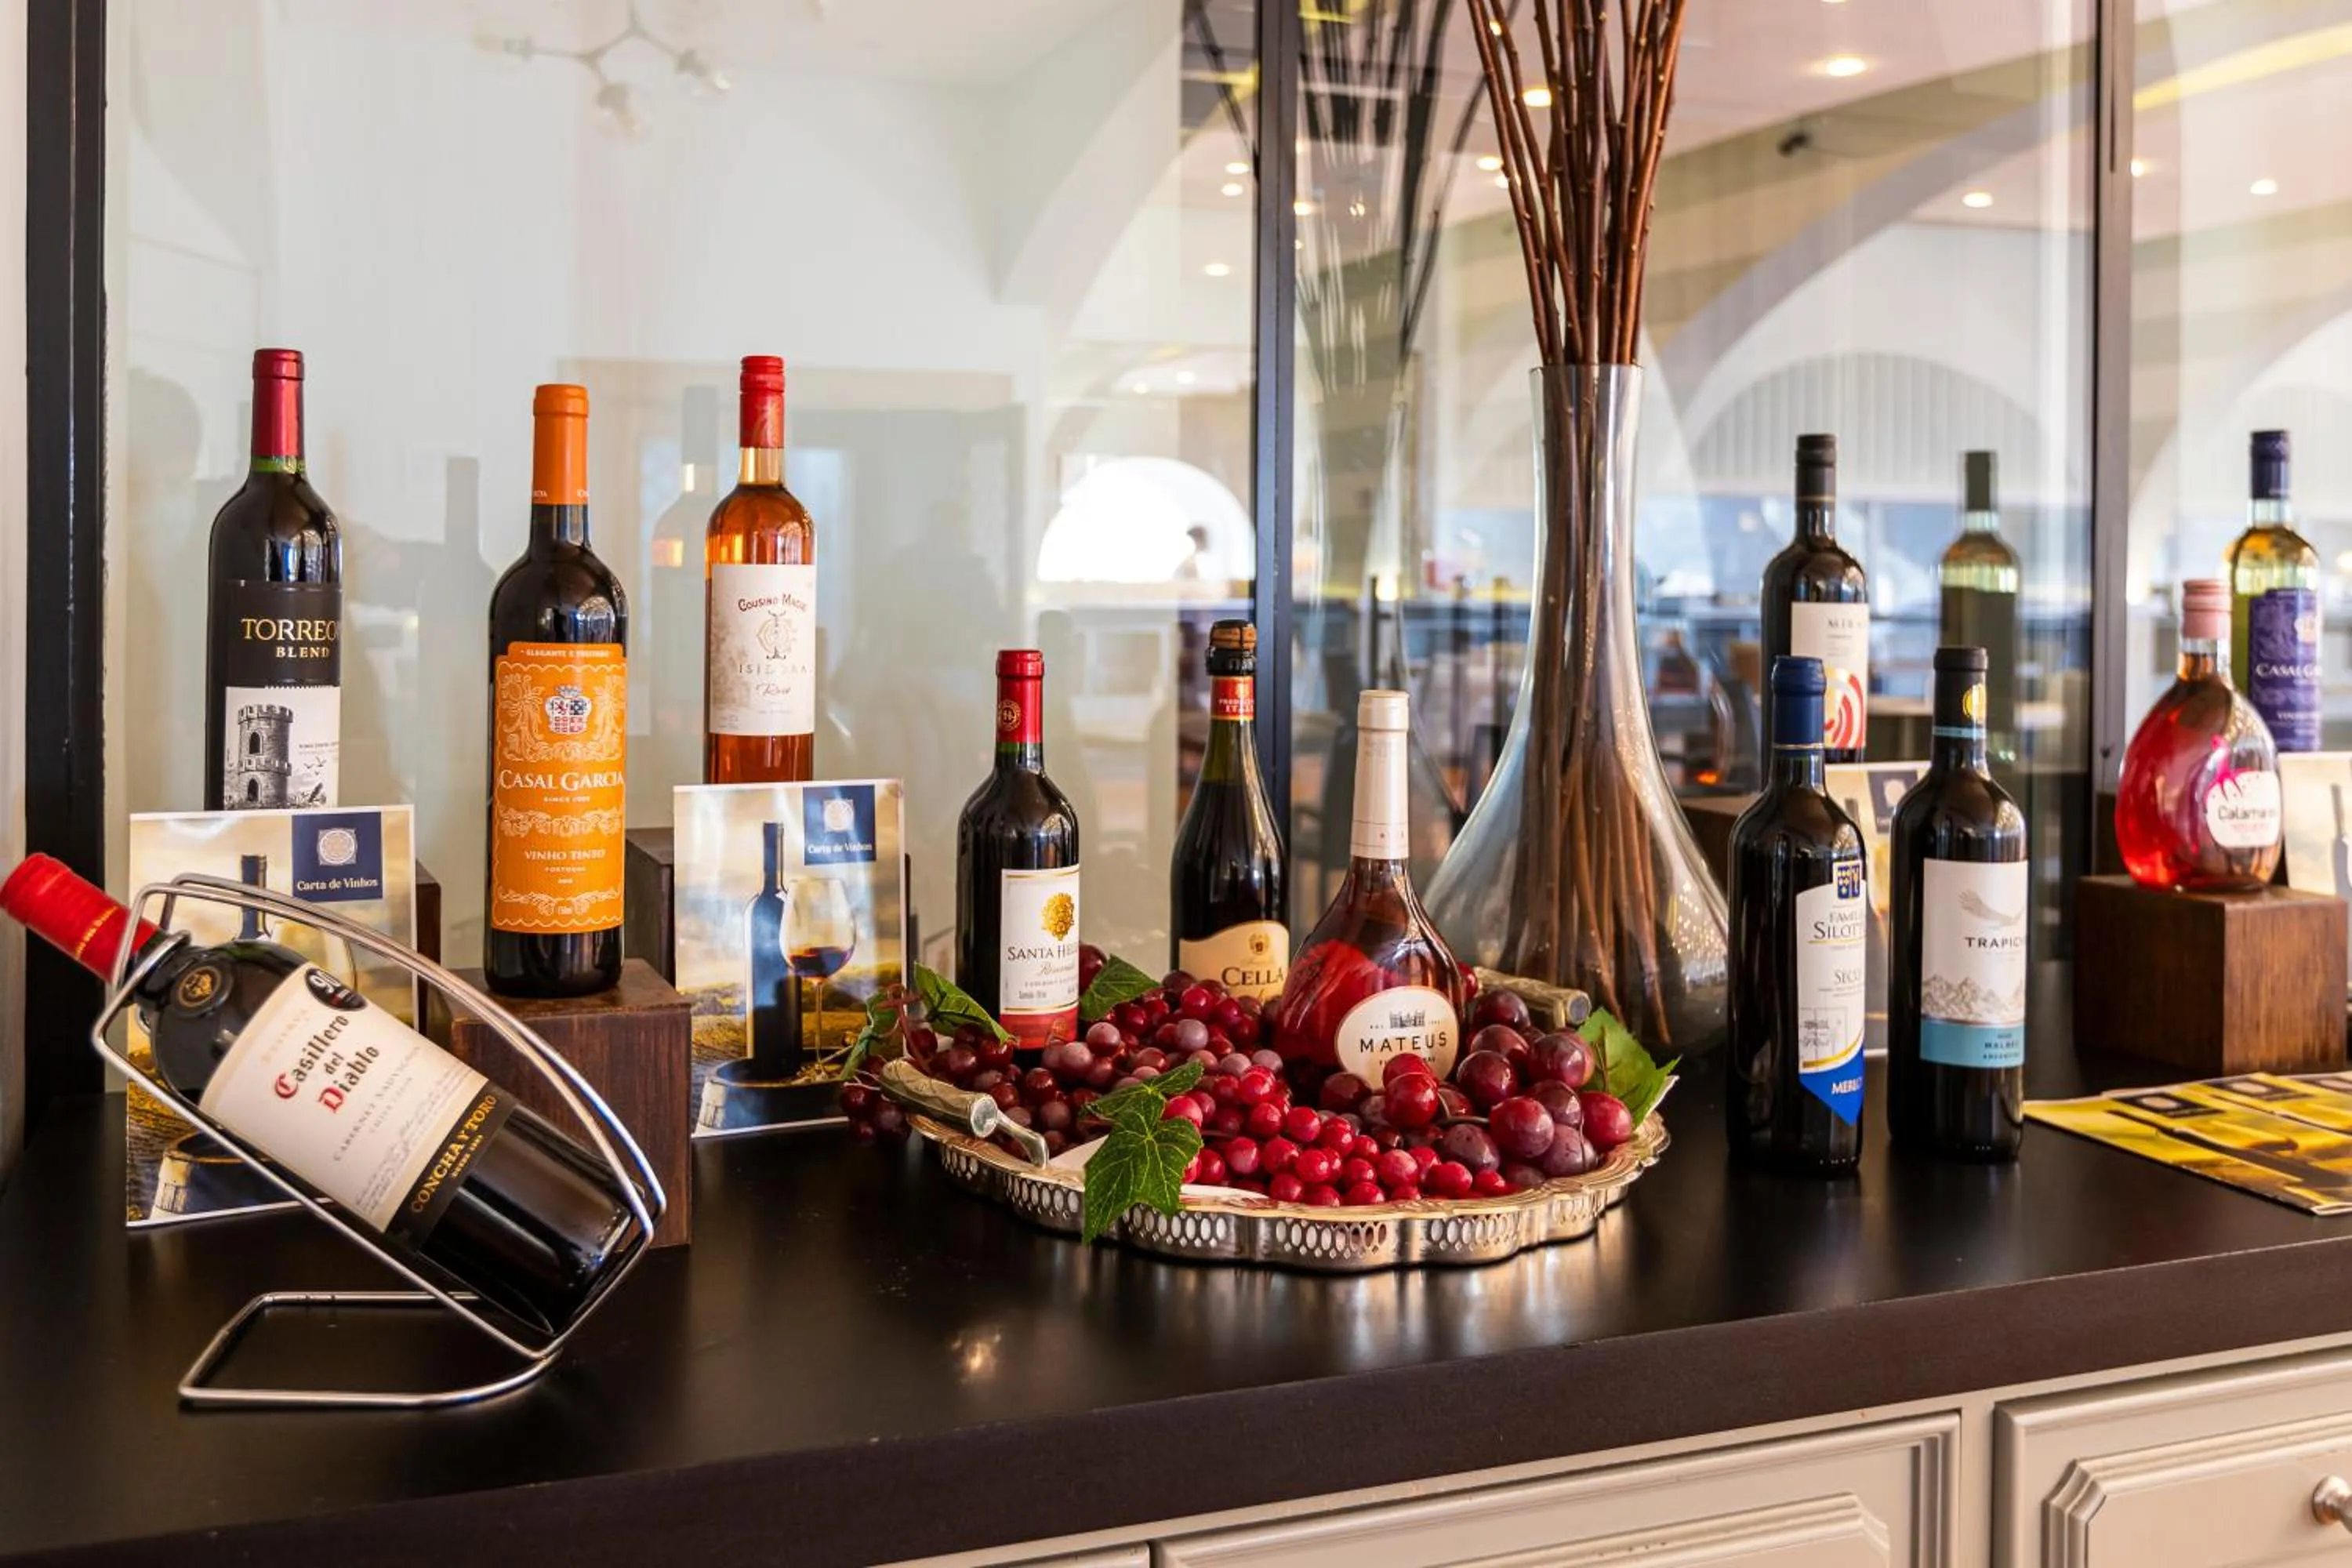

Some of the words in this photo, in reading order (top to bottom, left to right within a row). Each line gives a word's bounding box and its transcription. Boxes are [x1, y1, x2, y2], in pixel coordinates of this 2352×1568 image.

[276, 646, 329, 658] BLEND
[499, 769, 557, 789] CASAL
[561, 771, 625, 792] GARCIA
[524, 851, 567, 860] VINHO
[570, 849, 606, 860] TINTO
[297, 880, 327, 891] Carta
[329, 878, 341, 890] de
[343, 877, 378, 889] Vinhos
[1007, 946, 1054, 961] SANTA
[1221, 966, 1284, 986] CELLA
[1360, 1031, 1447, 1053] MATEUS
[275, 1015, 350, 1100] Casillero
[324, 1051, 345, 1075] del
[317, 1045, 380, 1113] Diablo
[410, 1141, 465, 1213] CONCHA
[458, 1130, 470, 1142] Y
[464, 1094, 498, 1131] TORO
